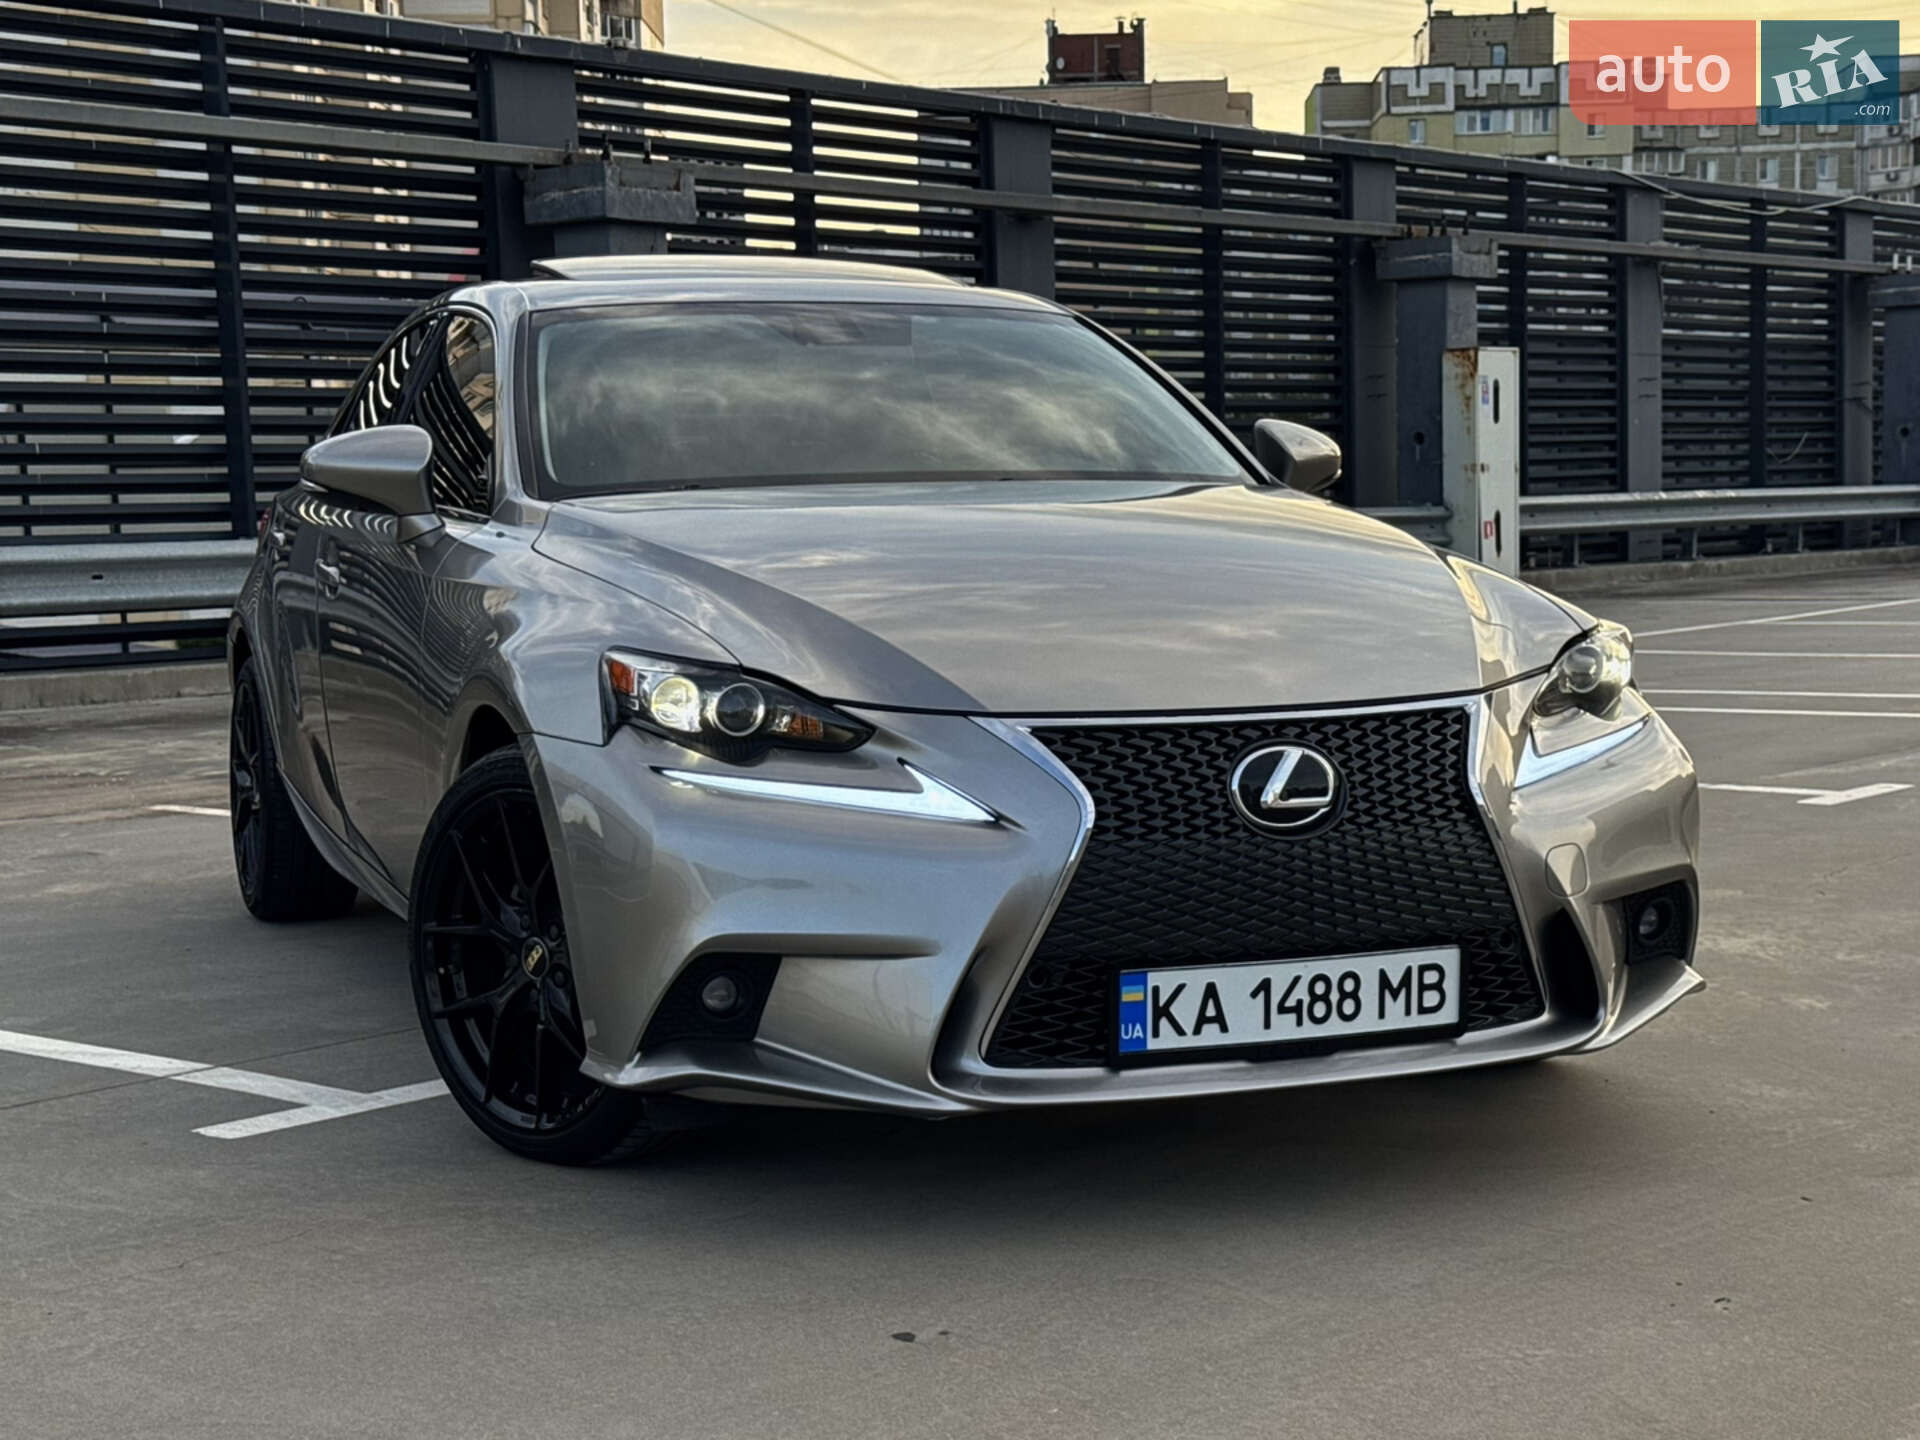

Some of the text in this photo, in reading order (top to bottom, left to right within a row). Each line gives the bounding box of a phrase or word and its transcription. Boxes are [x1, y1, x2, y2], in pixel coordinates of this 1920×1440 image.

[1151, 962, 1446, 1039] KA 1488 MB
[1121, 1023, 1144, 1040] UA
